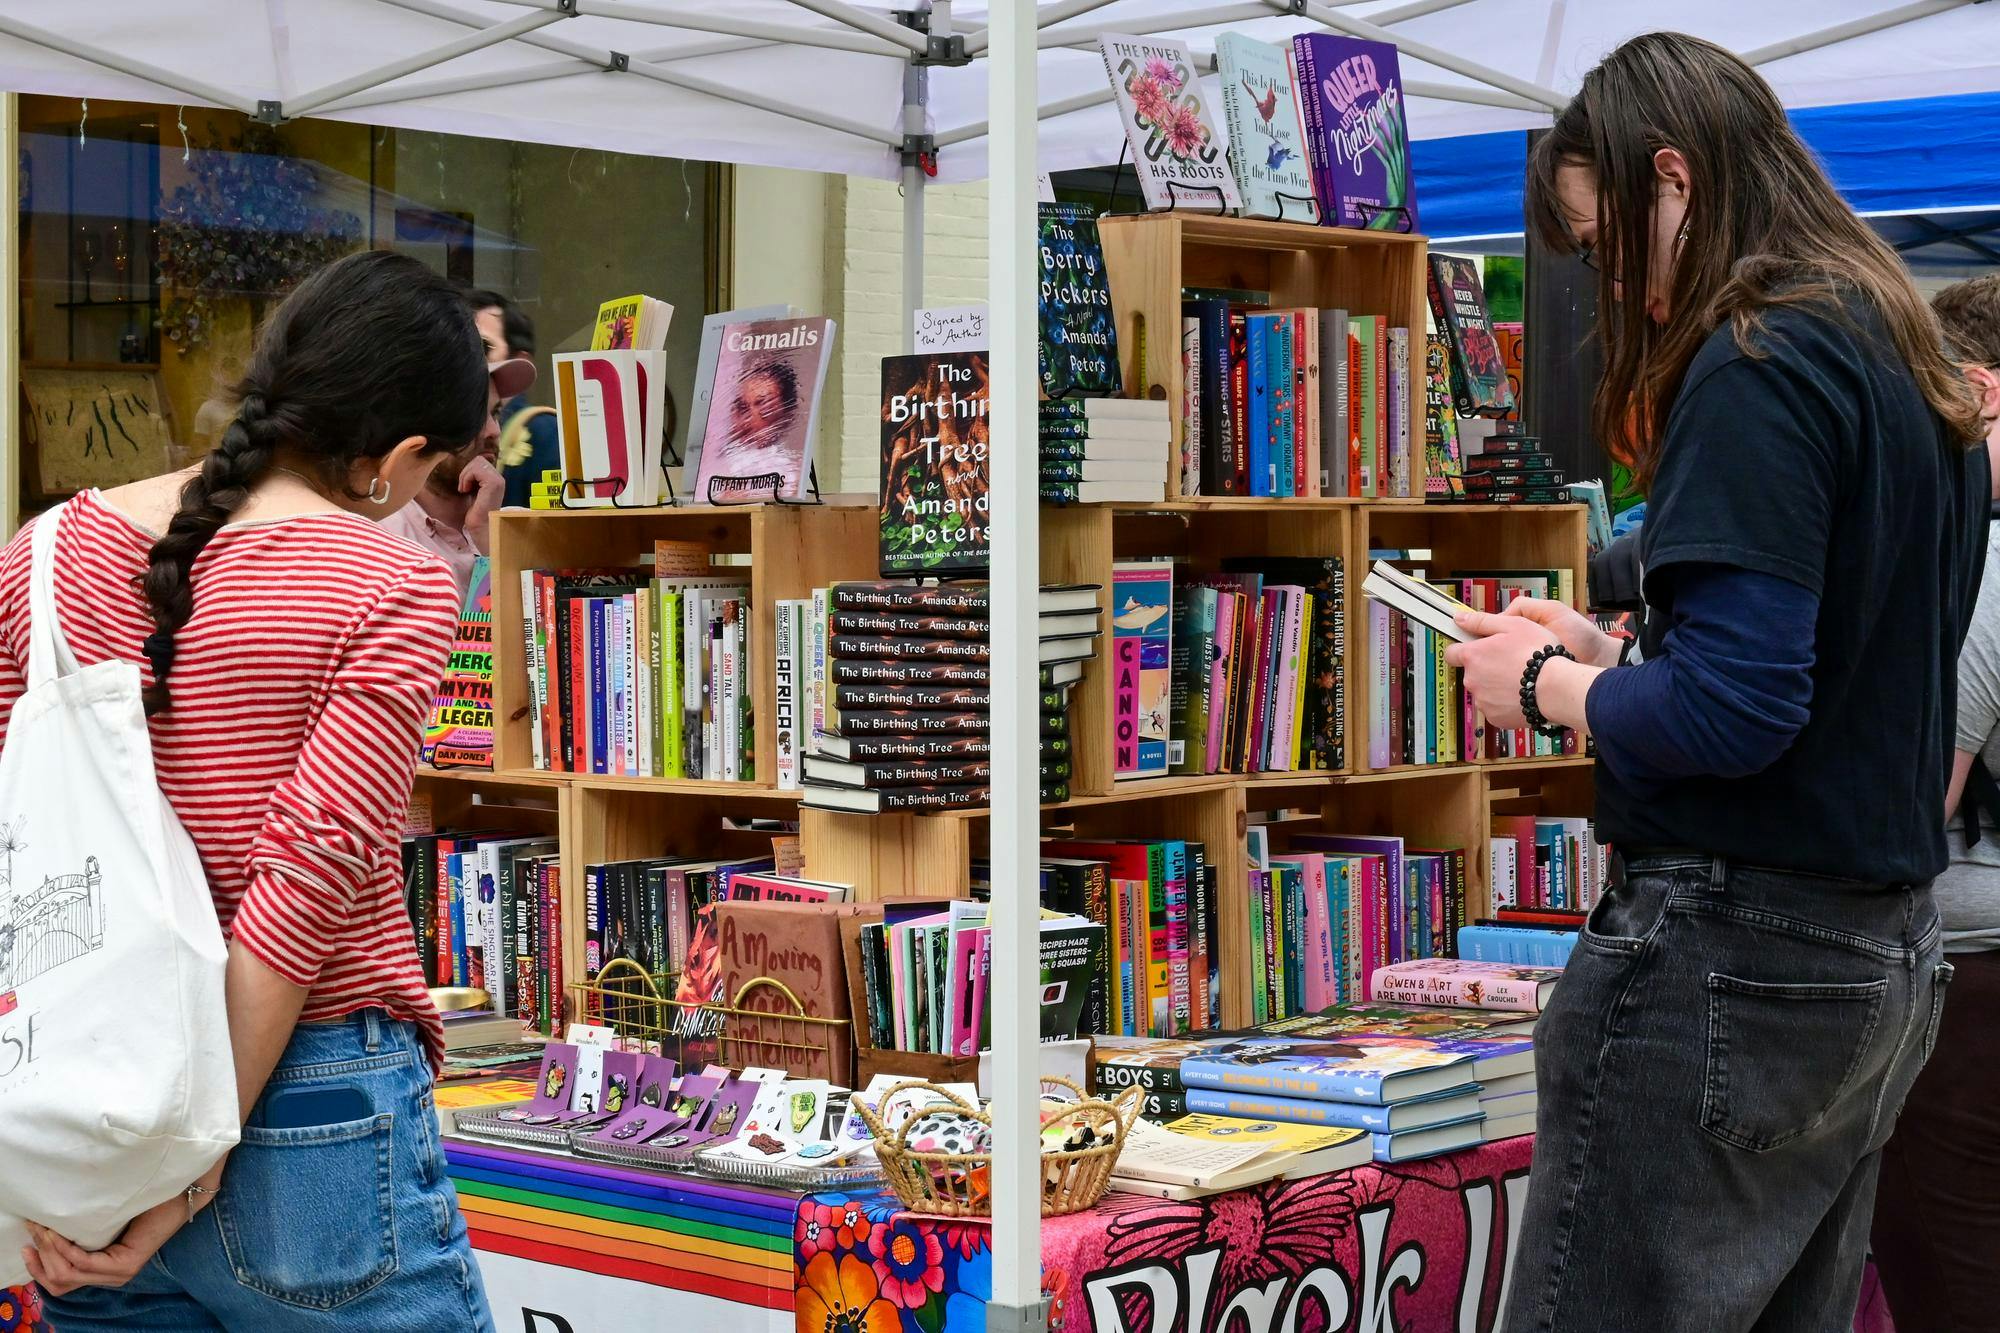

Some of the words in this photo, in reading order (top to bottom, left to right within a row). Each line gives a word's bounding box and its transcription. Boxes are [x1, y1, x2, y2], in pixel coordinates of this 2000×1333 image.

[1113, 42, 1140, 58] THE
[1142, 46, 1181, 62] RIVER
[1240, 67, 1258, 86] This
[1259, 73, 1269, 88] Is
[1270, 77, 1290, 95] How
[1322, 54, 1383, 113] QUEER
[1254, 120, 1269, 138] You
[1268, 123, 1291, 140] Lose
[1330, 78, 1398, 176] Nightmares
[1150, 163, 1176, 178] HAS
[1180, 165, 1225, 180] ROOTS
[1251, 165, 1266, 181] the
[1267, 167, 1289, 185] Time
[1289, 171, 1309, 190] War
[1183, 191, 1233, 202] EL-MOHR
[1054, 207, 1093, 216] BESTSELLER
[1050, 224, 1075, 241] The
[1041, 246, 1095, 276] Berry
[1041, 281, 1108, 306] Pickers
[1453, 288, 1474, 303] NEVER
[1455, 302, 1482, 318] WHISTLE
[921, 311, 966, 335] Signed
[969, 311, 985, 330] by
[1458, 318, 1469, 333] AT
[1467, 319, 1485, 335] NIGHT
[727, 325, 818, 351] Carnalis
[919, 332, 936, 346] the
[942, 330, 984, 346] Author
[1060, 327, 1107, 345] Amanda
[1281, 326, 1291, 372] WANDERING
[937, 363, 972, 383] The
[1070, 353, 1106, 374] Peters
[1219, 348, 1229, 400] HUNTING
[1282, 375, 1291, 398] STARS
[1337, 360, 1347, 417] NOOPIMING
[890, 391, 990, 424] Birthin
[1283, 410, 1291, 441] TOMMY
[919, 437, 989, 464] Tree
[1221, 419, 1232, 463] STARS
[1283, 443, 1292, 475] ORANGE
[712, 477, 748, 492] TIFFANY
[926, 480, 940, 491] a
[946, 465, 985, 488] novel
[902, 493, 990, 516] Amand
[911, 523, 990, 545] Peters
[885, 552, 925, 561] BESTSELLING
[926, 551, 951, 559] AUTHOR
[1334, 570, 1344, 595] ALIX
[838, 591, 854, 602] The
[855, 591, 892, 605] Birthing
[894, 594, 912, 604] Tree
[922, 595, 956, 606] Amanda
[959, 596, 987, 607] Peters
[455, 627, 491, 642] QUEE
[665, 603, 673, 661] RECONSIDERING
[839, 617, 855, 628] The
[858, 617, 896, 630] Birthing
[899, 618, 919, 629] Tree
[929, 620, 967, 631] Amanda
[1334, 610, 1344, 657] HARROW
[651, 631, 659, 667] ZAMI
[813, 622, 825, 668] QUEER
[839, 642, 856, 653] The
[859, 641, 901, 655] Birthing
[904, 643, 926, 654] Tree
[936, 644, 976, 654] Amanda
[447, 653, 492, 670] HERO
[724, 653, 732, 676] SAND
[839, 667, 859, 678] The
[861, 666, 906, 680] Birthing
[909, 668, 932, 679] Tree
[944, 668, 986, 680] Amanda
[1336, 666, 1344, 681] THE
[724, 677, 732, 699] TALK
[777, 659, 791, 729] AFRICA
[845, 692, 865, 703] The
[868, 692, 914, 705] Birthing
[917, 694, 941, 704] Tree
[953, 694, 989, 704] Amand
[455, 699, 474, 708] AND
[1116, 640, 1134, 768] CANON
[1336, 683, 1344, 737] EVERLASTING
[440, 709, 492, 727] LEGEN
[615, 710, 624, 747] FAIREST
[850, 719, 870, 729] The
[873, 718, 918, 731] Birthing
[922, 719, 946, 730] Tree
[438, 751, 457, 759] DAN
[458, 753, 486, 762] JONES
[858, 743, 879, 754] The
[881, 743, 926, 756] Birthing
[929, 743, 953, 753] Tree
[874, 769, 893, 780] The
[896, 768, 940, 782] Birthing
[941, 767, 963, 778] Tree
[888, 795, 906, 806] The
[908, 793, 947, 806] Birthing
[950, 791, 970, 802] Tree
[1195, 852, 1204, 864] TO
[463, 863, 473, 898] BAD
[500, 869, 509, 887] MY
[1092, 868, 1103, 897] BURY
[1151, 849, 1161, 908] WHITEHEAD
[1196, 866, 1205, 882] THE
[587, 874, 598, 931] MOONFLOW
[1196, 885, 1206, 911] MOON
[501, 890, 513, 929] DEAR
[517, 900, 528, 932] OCTAVIA'S
[1379, 897, 1388, 942] Divination
[466, 901, 475, 941] CREE
[1197, 912, 1207, 930] AND
[488, 928, 497, 977] SINGULAR
[517, 933, 528, 955] BROOD
[722, 915, 741, 969] A
[742, 931, 822, 991] Moving
[1040, 940, 1067, 950] RECIPES
[1068, 937, 1089, 947] MADE
[1198, 932, 1207, 957] BACK
[1320, 929, 1329, 960] ROYAL
[503, 934, 514, 976] HENRY
[1039, 950, 1056, 960] HREE
[1057, 957, 1088, 968] SQUASH
[490, 979, 498, 998] LIFE
[1173, 963, 1189, 1018] SISTERS
[1384, 974, 1416, 990] GWEN
[1418, 979, 1425, 990] &
[1427, 976, 1452, 992] ART
[1496, 987, 1508, 995] LEX
[1377, 991, 1395, 1001] ARE
[1399, 992, 1417, 1003] NOT
[1421, 993, 1431, 1004] IN
[1434, 994, 1459, 1006] LOVE
[1487, 995, 1518, 1004] CROUCHER
[1105, 1065, 1155, 1089] BOYS
[1184, 1071, 1203, 1080] AVERY
[1203, 1072, 1220, 1082] IRONS
[1190, 1099, 1208, 1108] AVERY
[1209, 1101, 1227, 1109] IRONS
